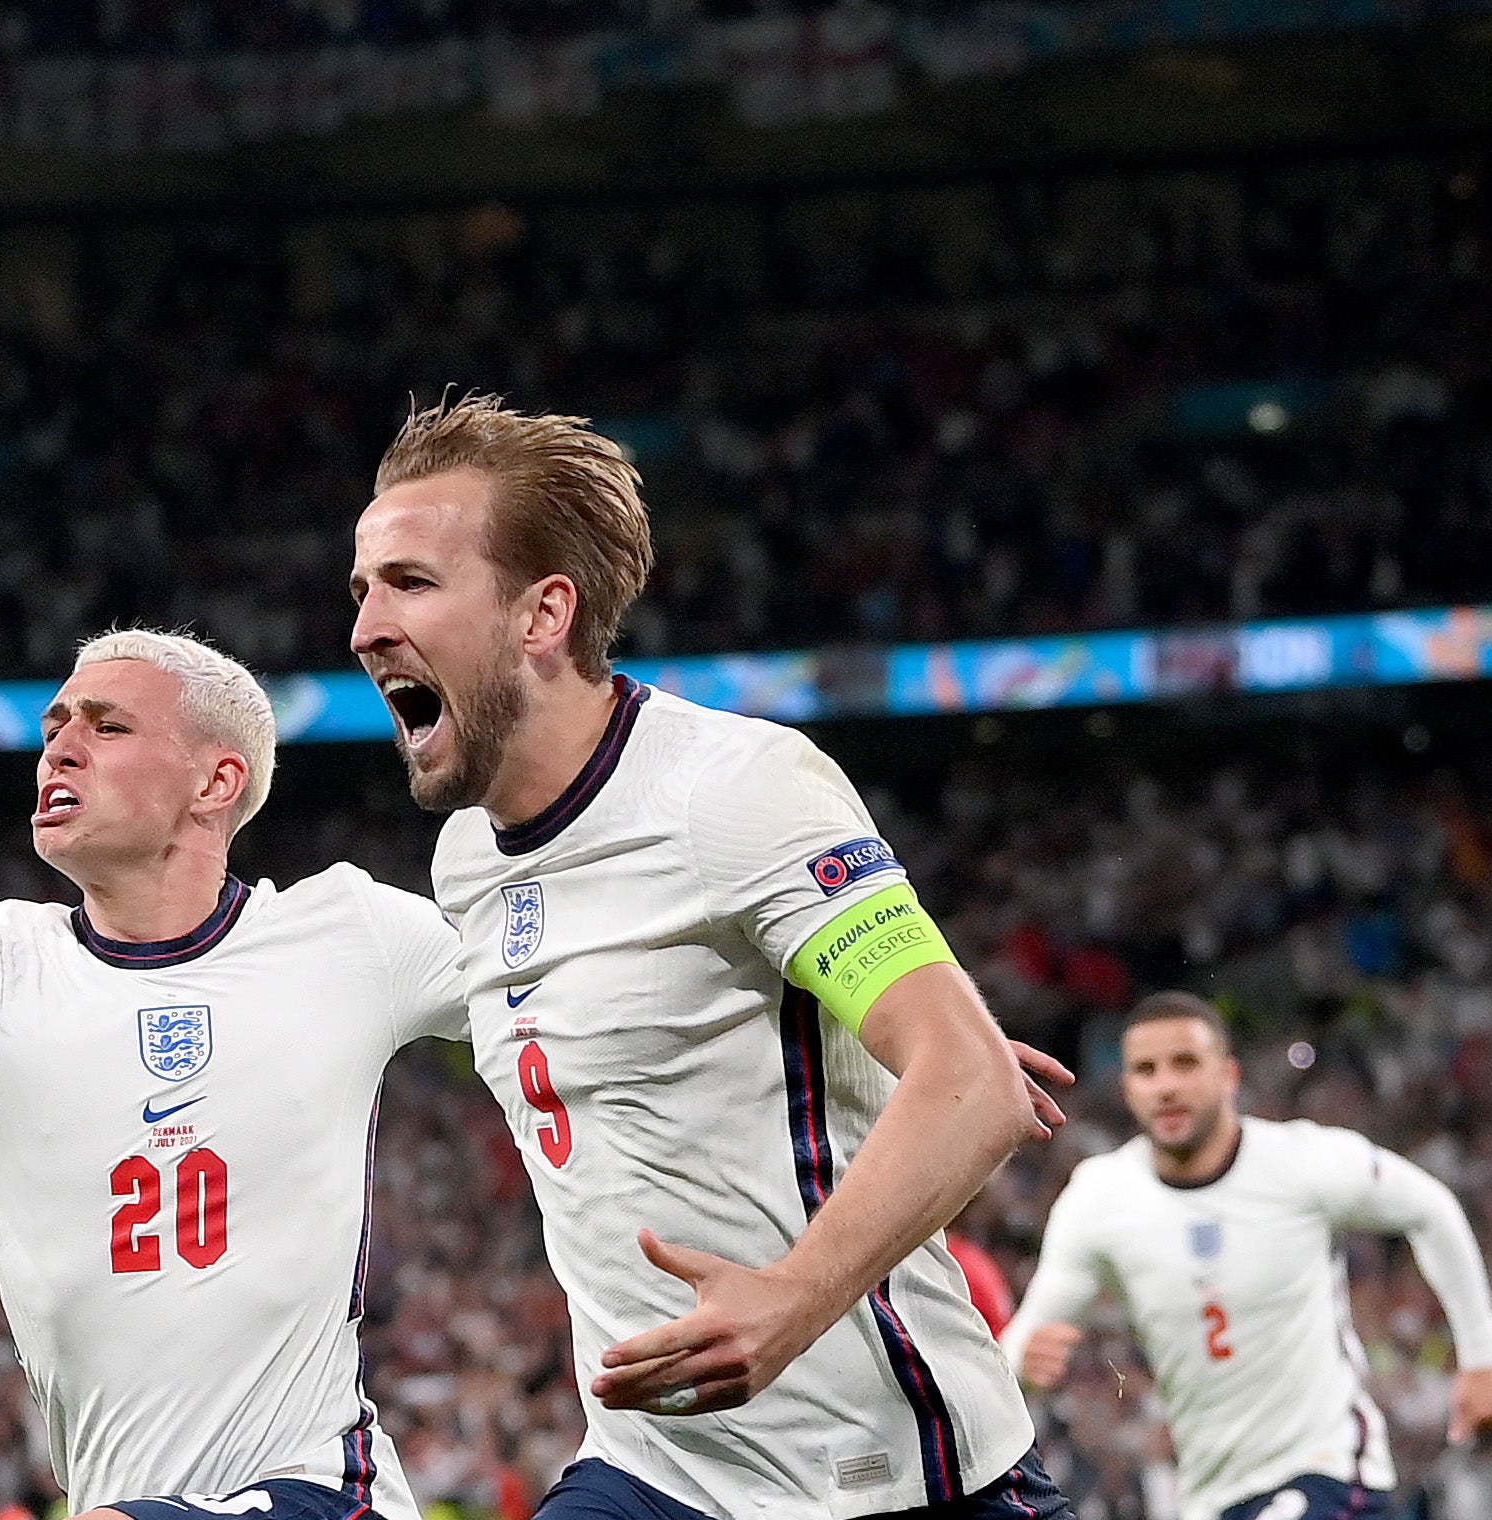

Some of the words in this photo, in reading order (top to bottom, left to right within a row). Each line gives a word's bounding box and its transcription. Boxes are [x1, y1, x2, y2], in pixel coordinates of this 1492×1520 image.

[817, 919, 876, 979] #EQUAL
[875, 903, 916, 926] GAME
[858, 926, 926, 970] RESPECT
[152, 1124, 195, 1137] DENMARK
[518, 1040, 573, 1169] 9
[155, 1138, 175, 1148] JULY
[110, 1147, 228, 1274] 20
[1203, 1304, 1234, 1359] 2
